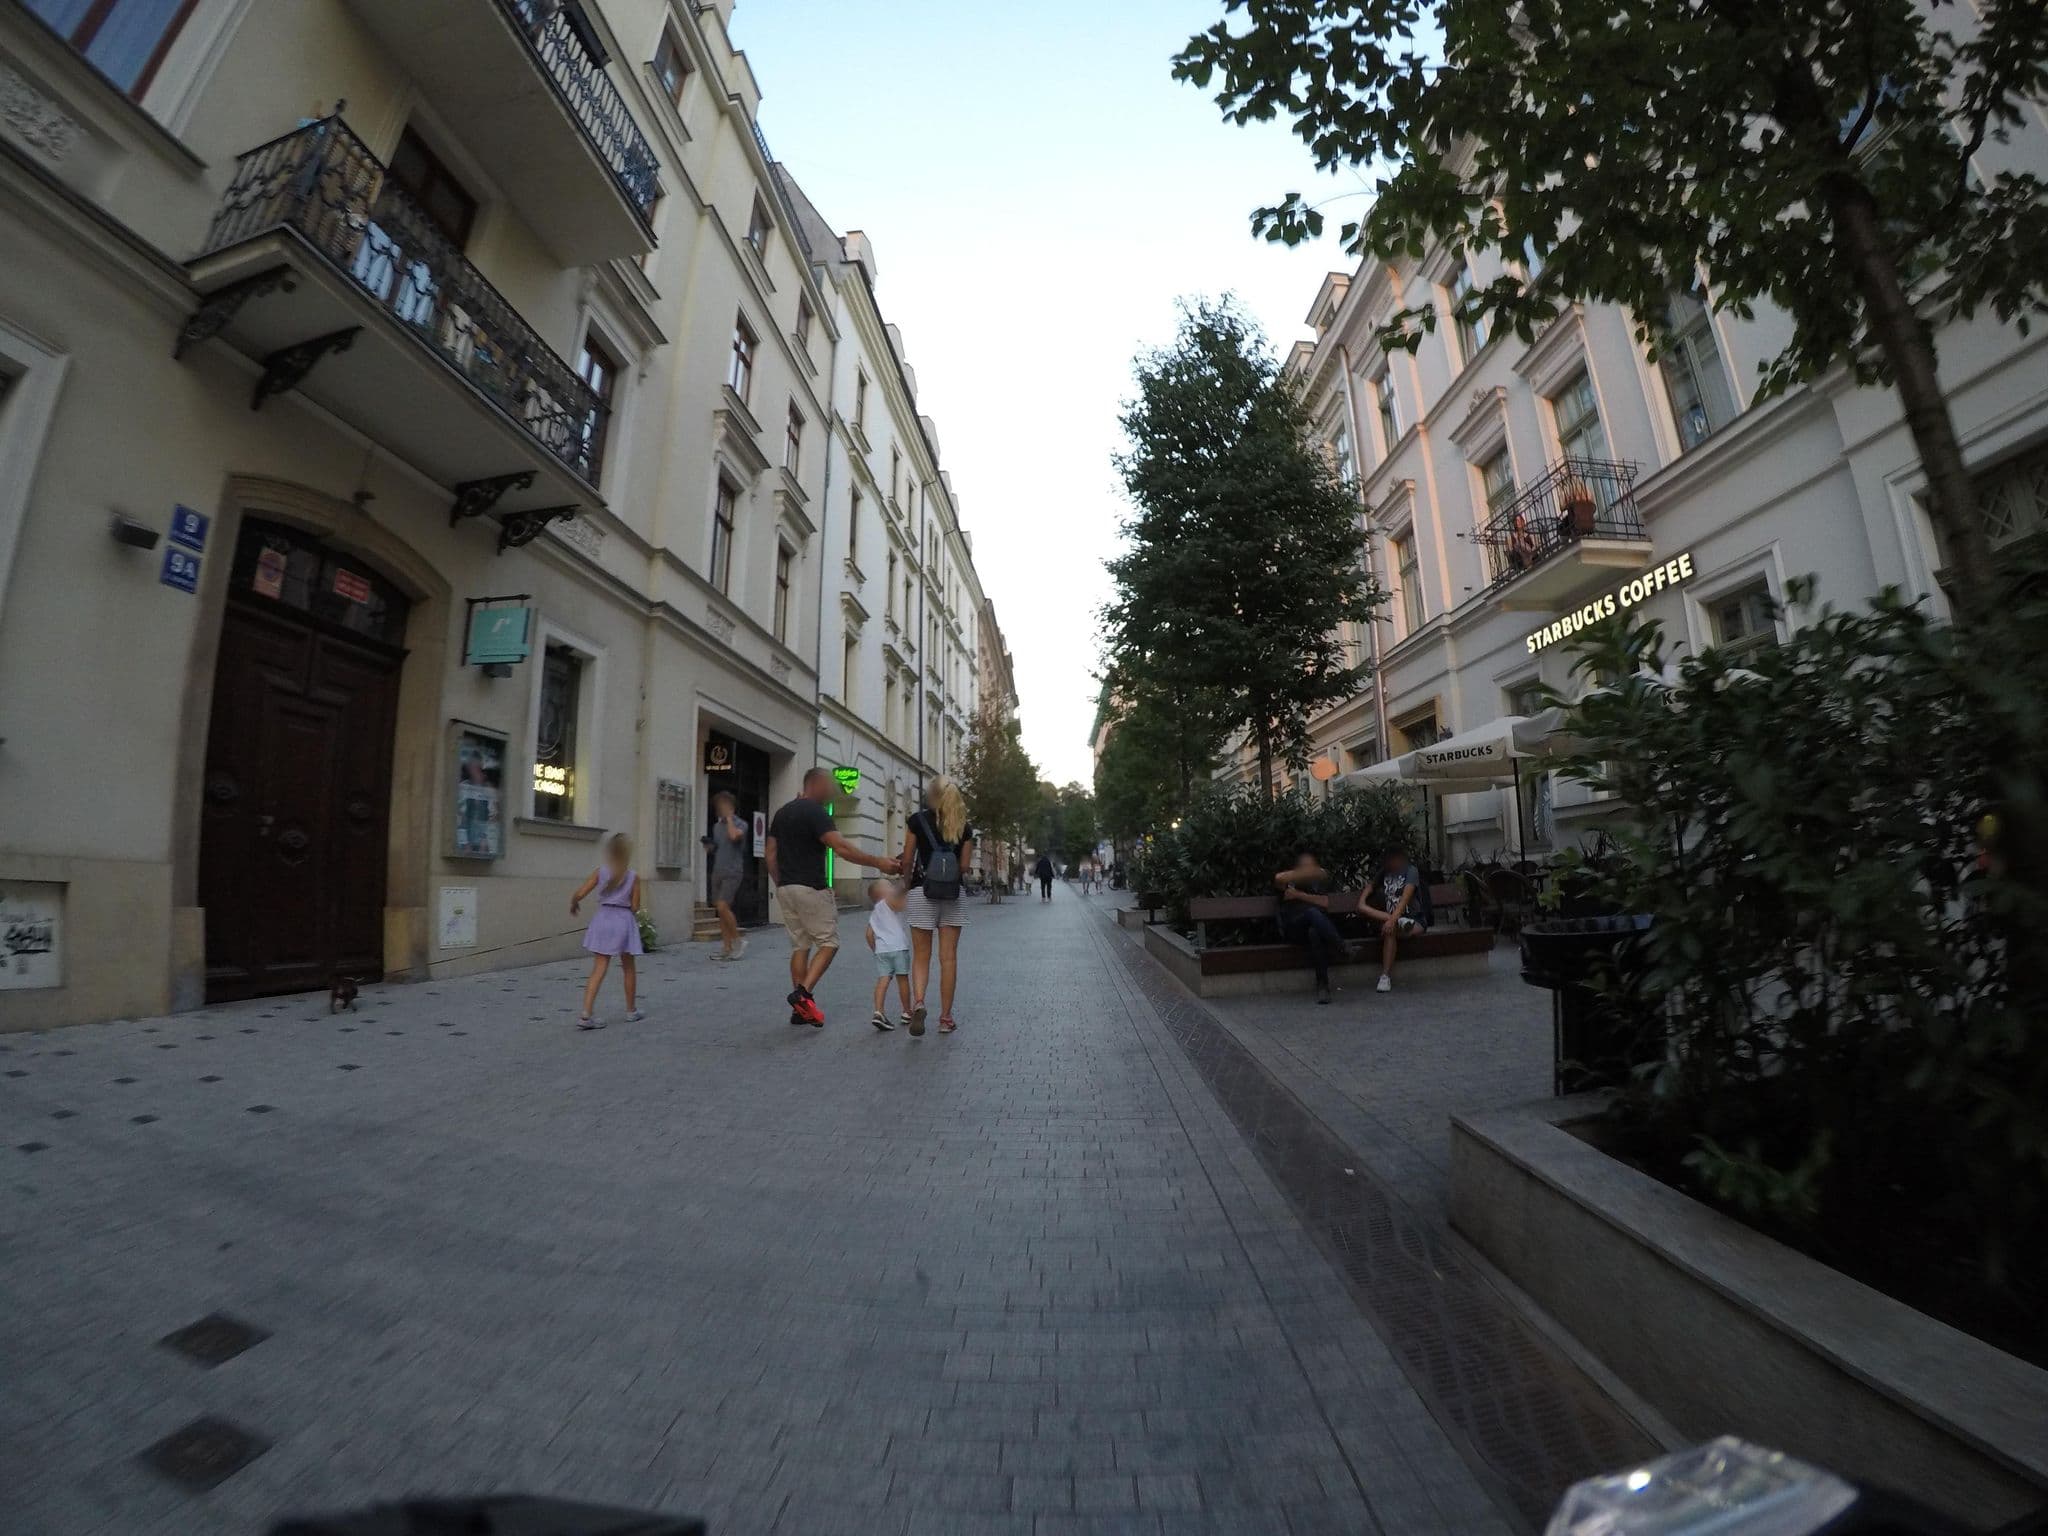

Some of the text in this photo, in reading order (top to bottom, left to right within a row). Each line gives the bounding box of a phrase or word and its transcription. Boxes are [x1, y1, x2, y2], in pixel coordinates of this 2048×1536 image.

[184, 514, 199, 533] 9
[171, 553, 196, 579] 9A
[1526, 552, 1693, 654] STARBUCKS COFFEE
[1426, 745, 1493, 764] STARBUCKS
